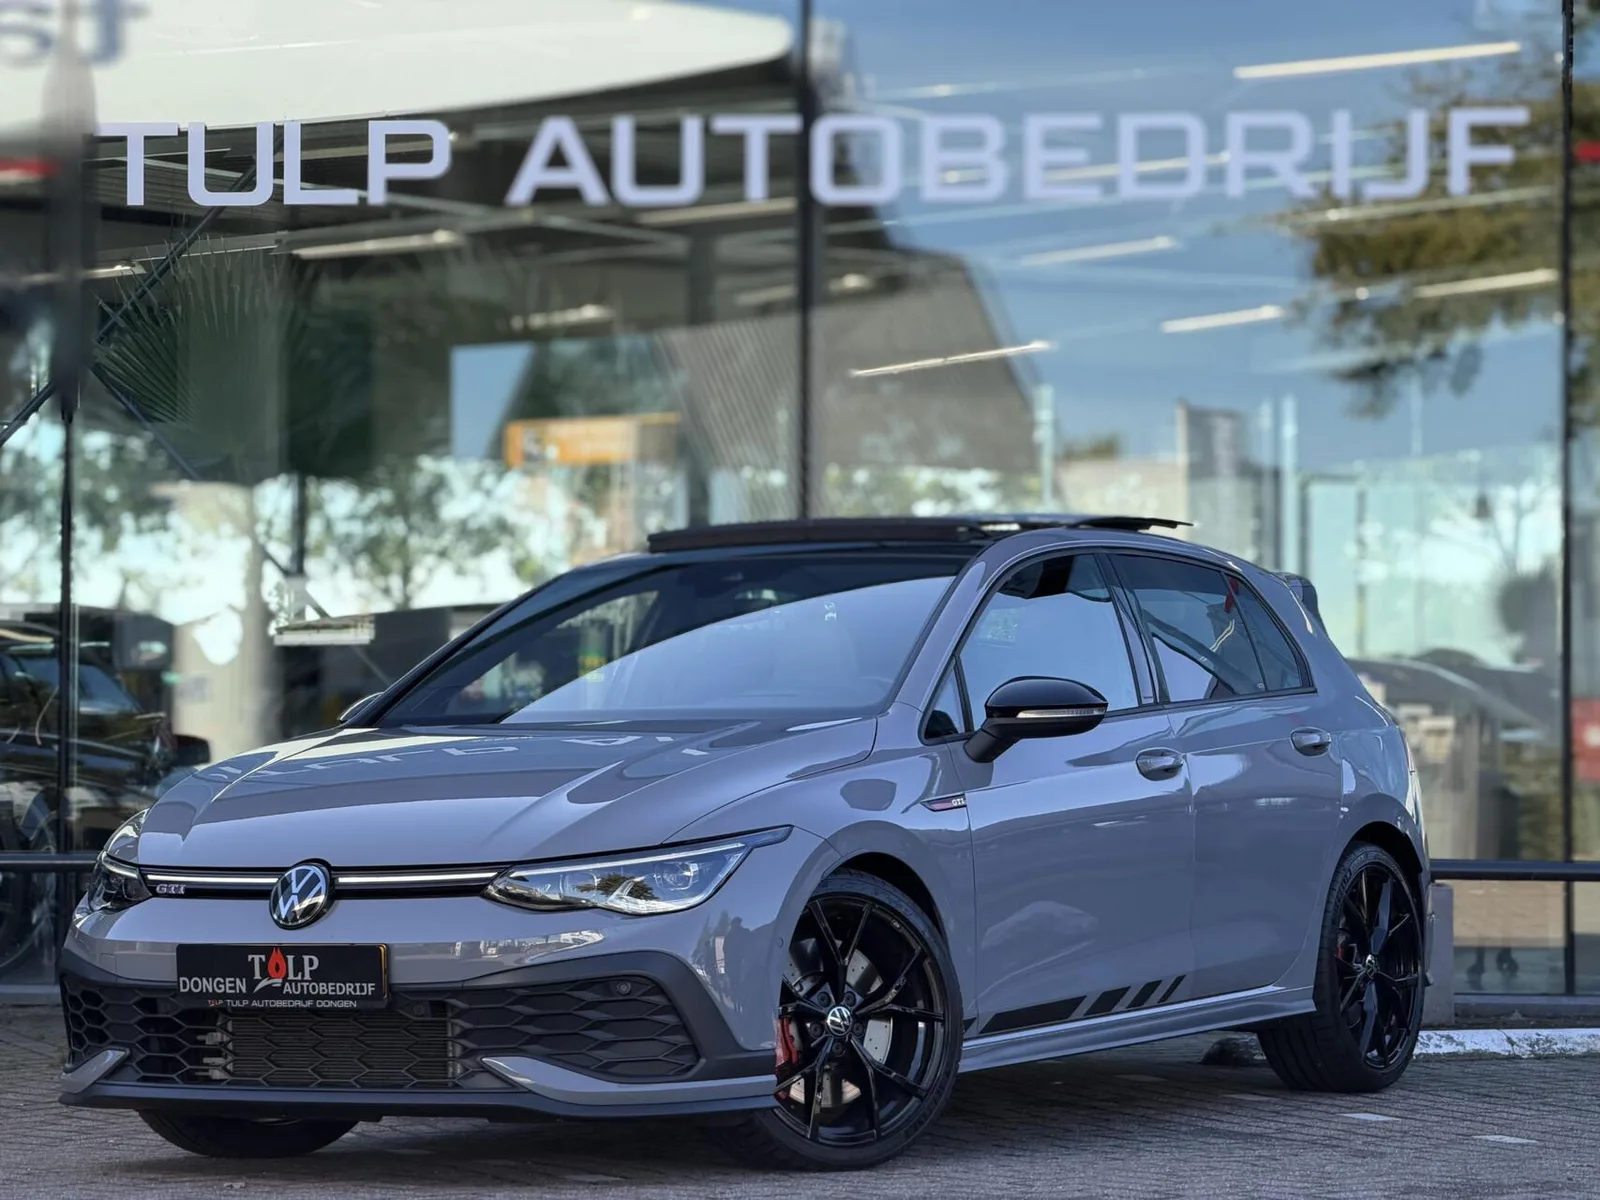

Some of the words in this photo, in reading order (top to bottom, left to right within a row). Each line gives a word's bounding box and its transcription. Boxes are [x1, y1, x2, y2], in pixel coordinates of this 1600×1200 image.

[94, 121, 452, 207] TULP
[507, 108, 1529, 207] AUTOBEDRIJF
[951, 798, 965, 806] GTI
[156, 883, 186, 895] GTI
[179, 976, 247, 994] DONGEN
[283, 982, 376, 996] AUTOBEDRIJF
[251, 1000, 314, 1008] AUTOBEDRIJF
[316, 1000, 357, 1008] DONGEN
